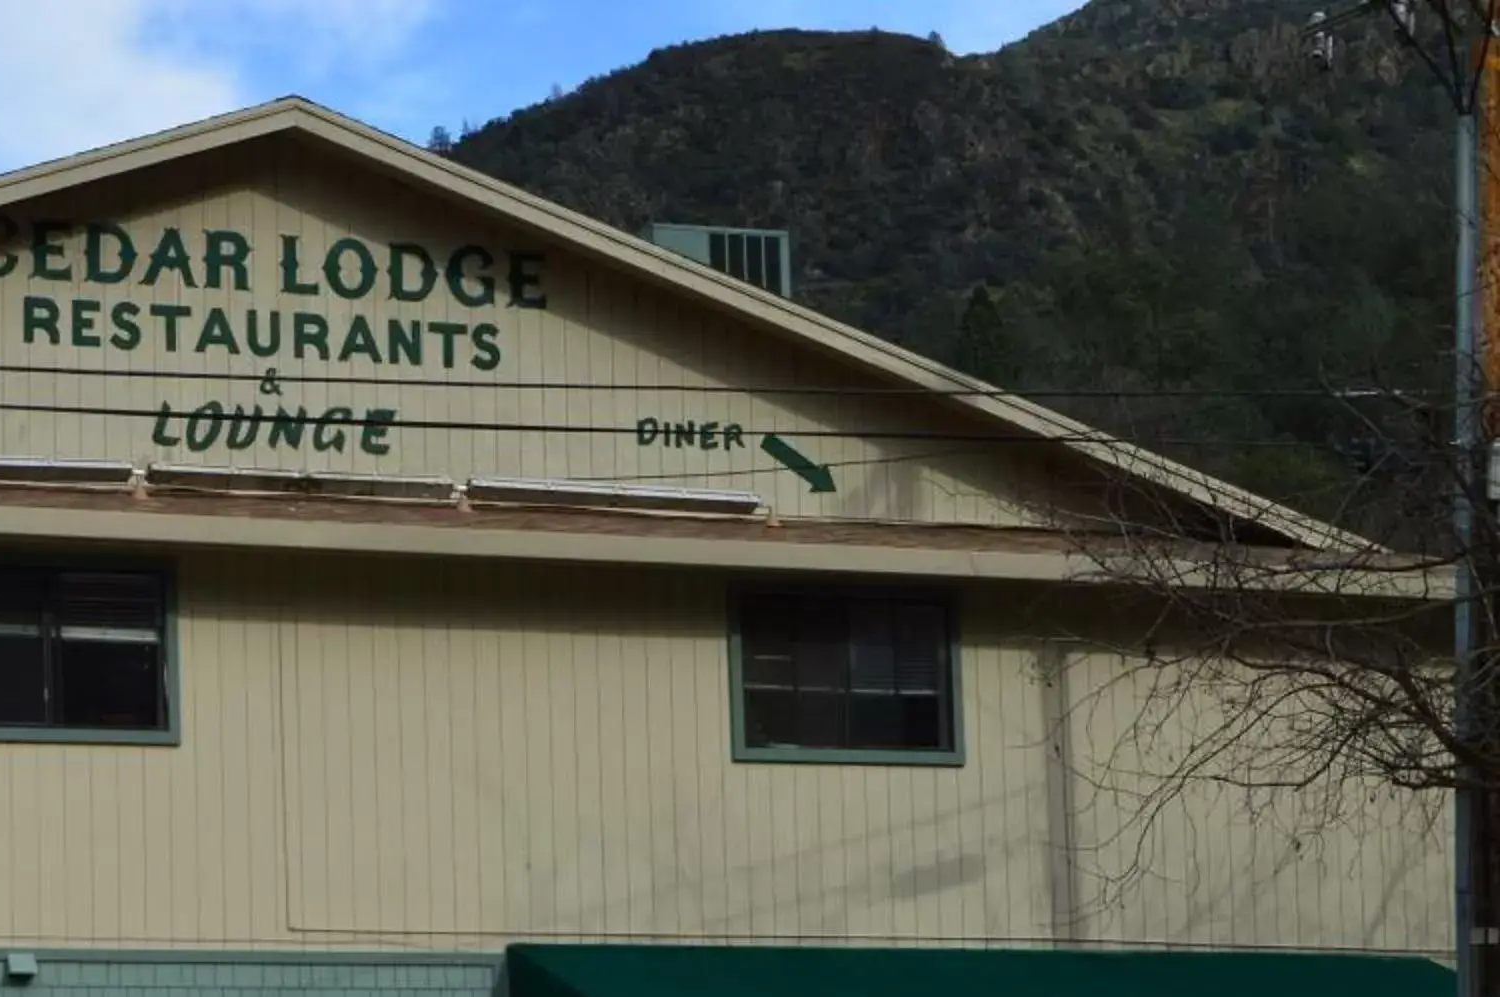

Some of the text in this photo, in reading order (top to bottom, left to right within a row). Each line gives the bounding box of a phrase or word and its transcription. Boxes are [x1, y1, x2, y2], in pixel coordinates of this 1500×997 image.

[279, 233, 549, 310] LODGE
[22, 295, 501, 371] RESTAURANTS
[259, 367, 283, 395] &
[151, 399, 397, 456] LOUNGE
[637, 417, 745, 450] DINER
